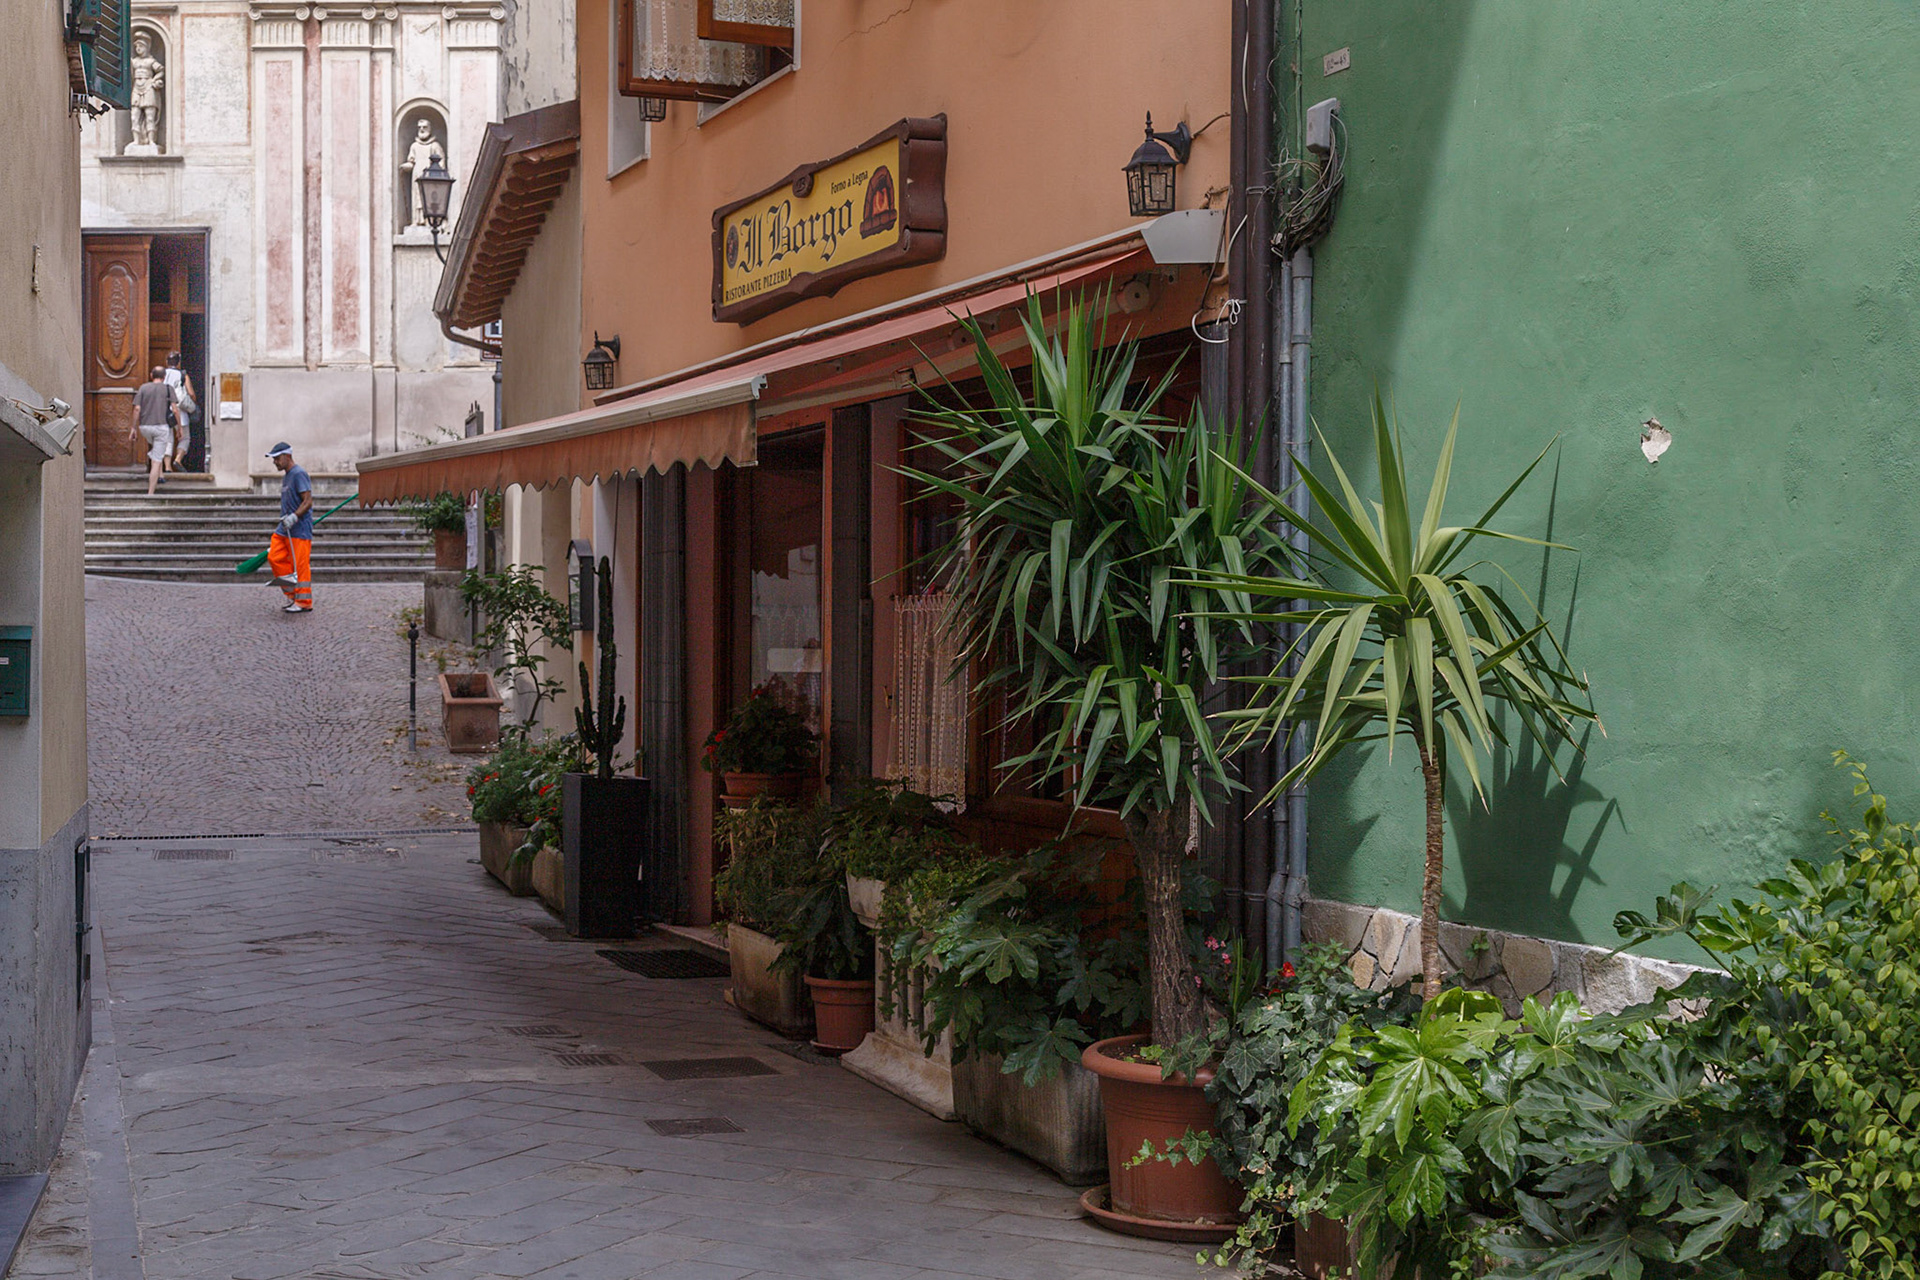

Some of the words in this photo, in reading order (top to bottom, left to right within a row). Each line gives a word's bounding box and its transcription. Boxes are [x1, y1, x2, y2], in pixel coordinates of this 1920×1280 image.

[831, 180, 846, 194] Forno
[847, 178, 851, 187] a
[852, 170, 868, 186] Legna
[738, 213, 763, 276] Il
[767, 199, 854, 267] Borgo
[725, 279, 762, 302] RISTORANTE
[763, 267, 792, 289] PIZZERIA
